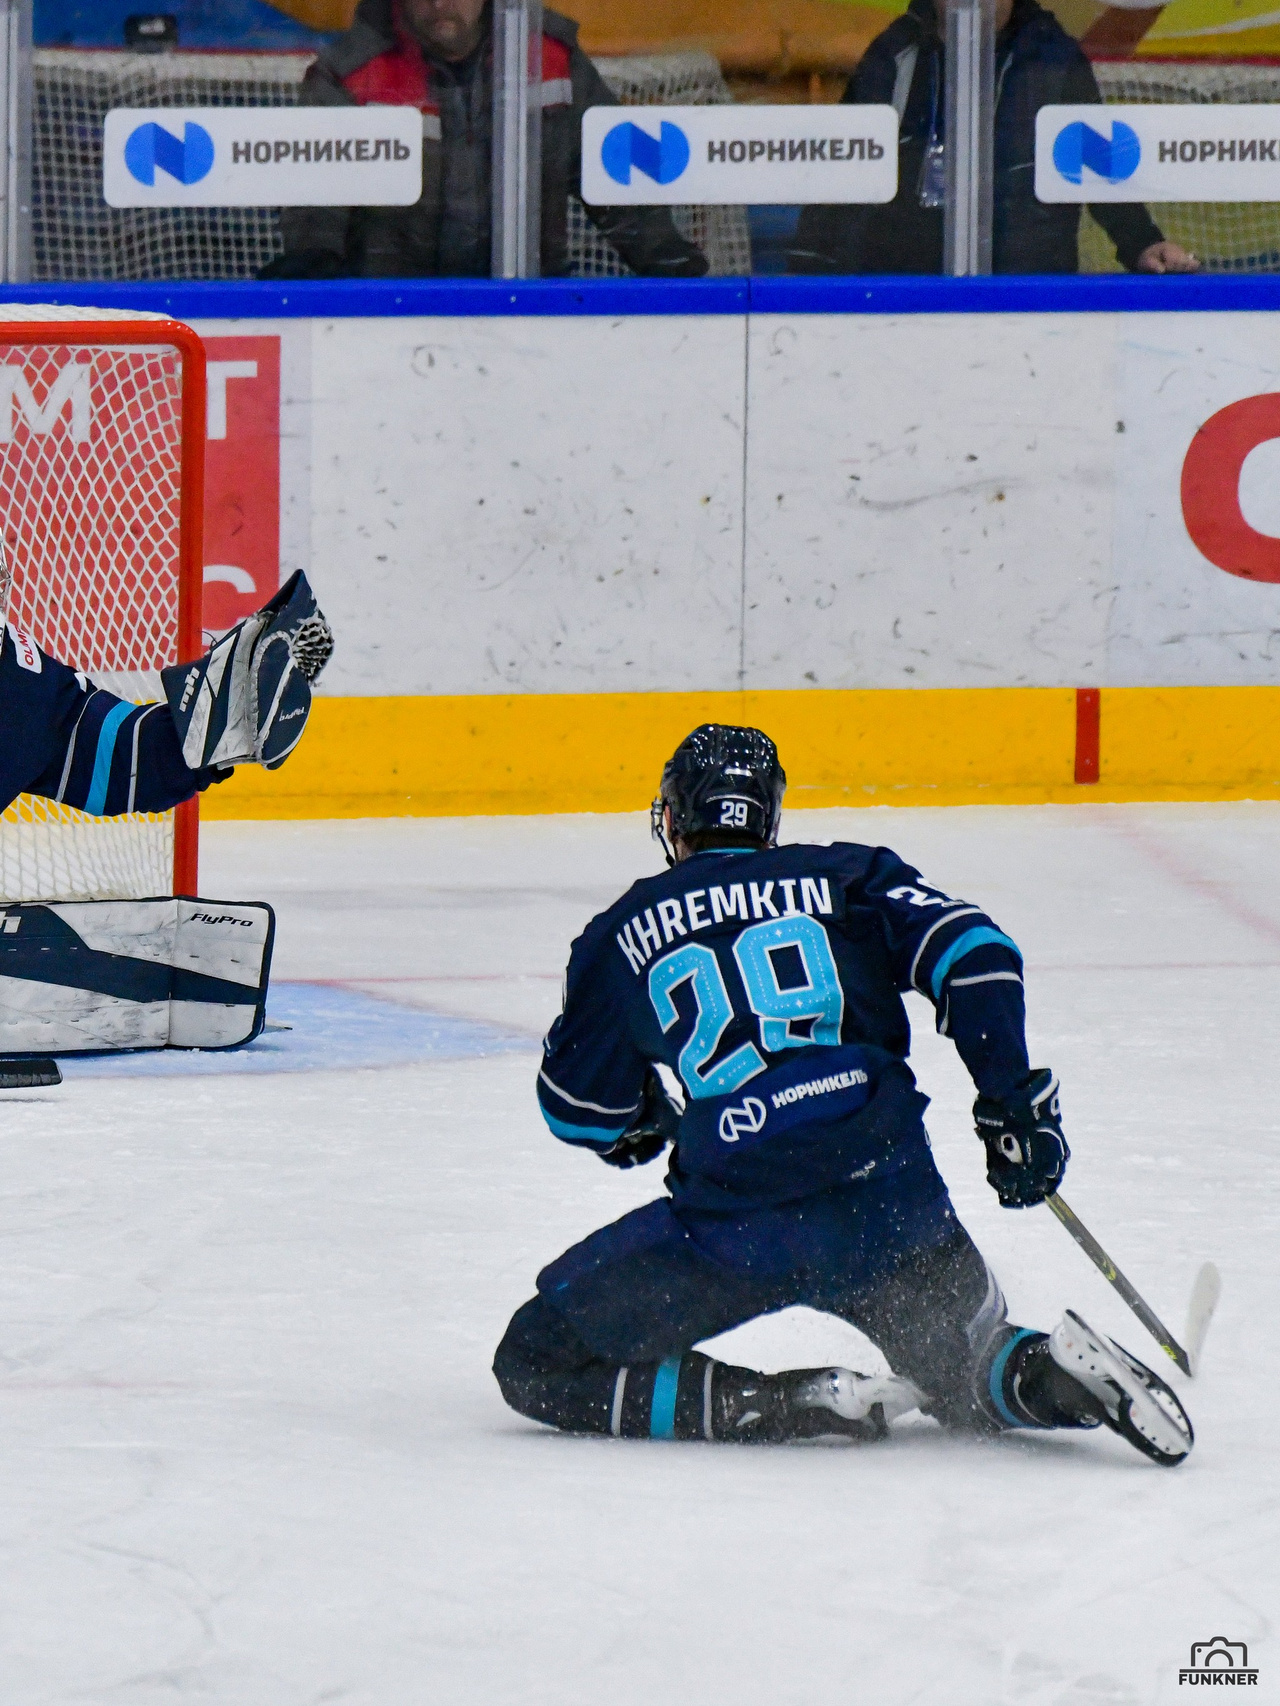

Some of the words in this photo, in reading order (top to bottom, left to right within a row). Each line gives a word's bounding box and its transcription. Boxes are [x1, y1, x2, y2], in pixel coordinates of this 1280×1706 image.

[231, 139, 411, 165] НОРНИКЕЛЬ
[707, 138, 884, 163] НОРНИКЕЛЬ
[1158, 139, 1280, 163] НОРНИК
[719, 800, 749, 828] 29
[190, 912, 254, 928] FlyPro
[617, 877, 833, 976] KHREMKIN
[648, 913, 845, 1100] 29
[771, 1069, 868, 1109] НОРНИКЕЛЬ
